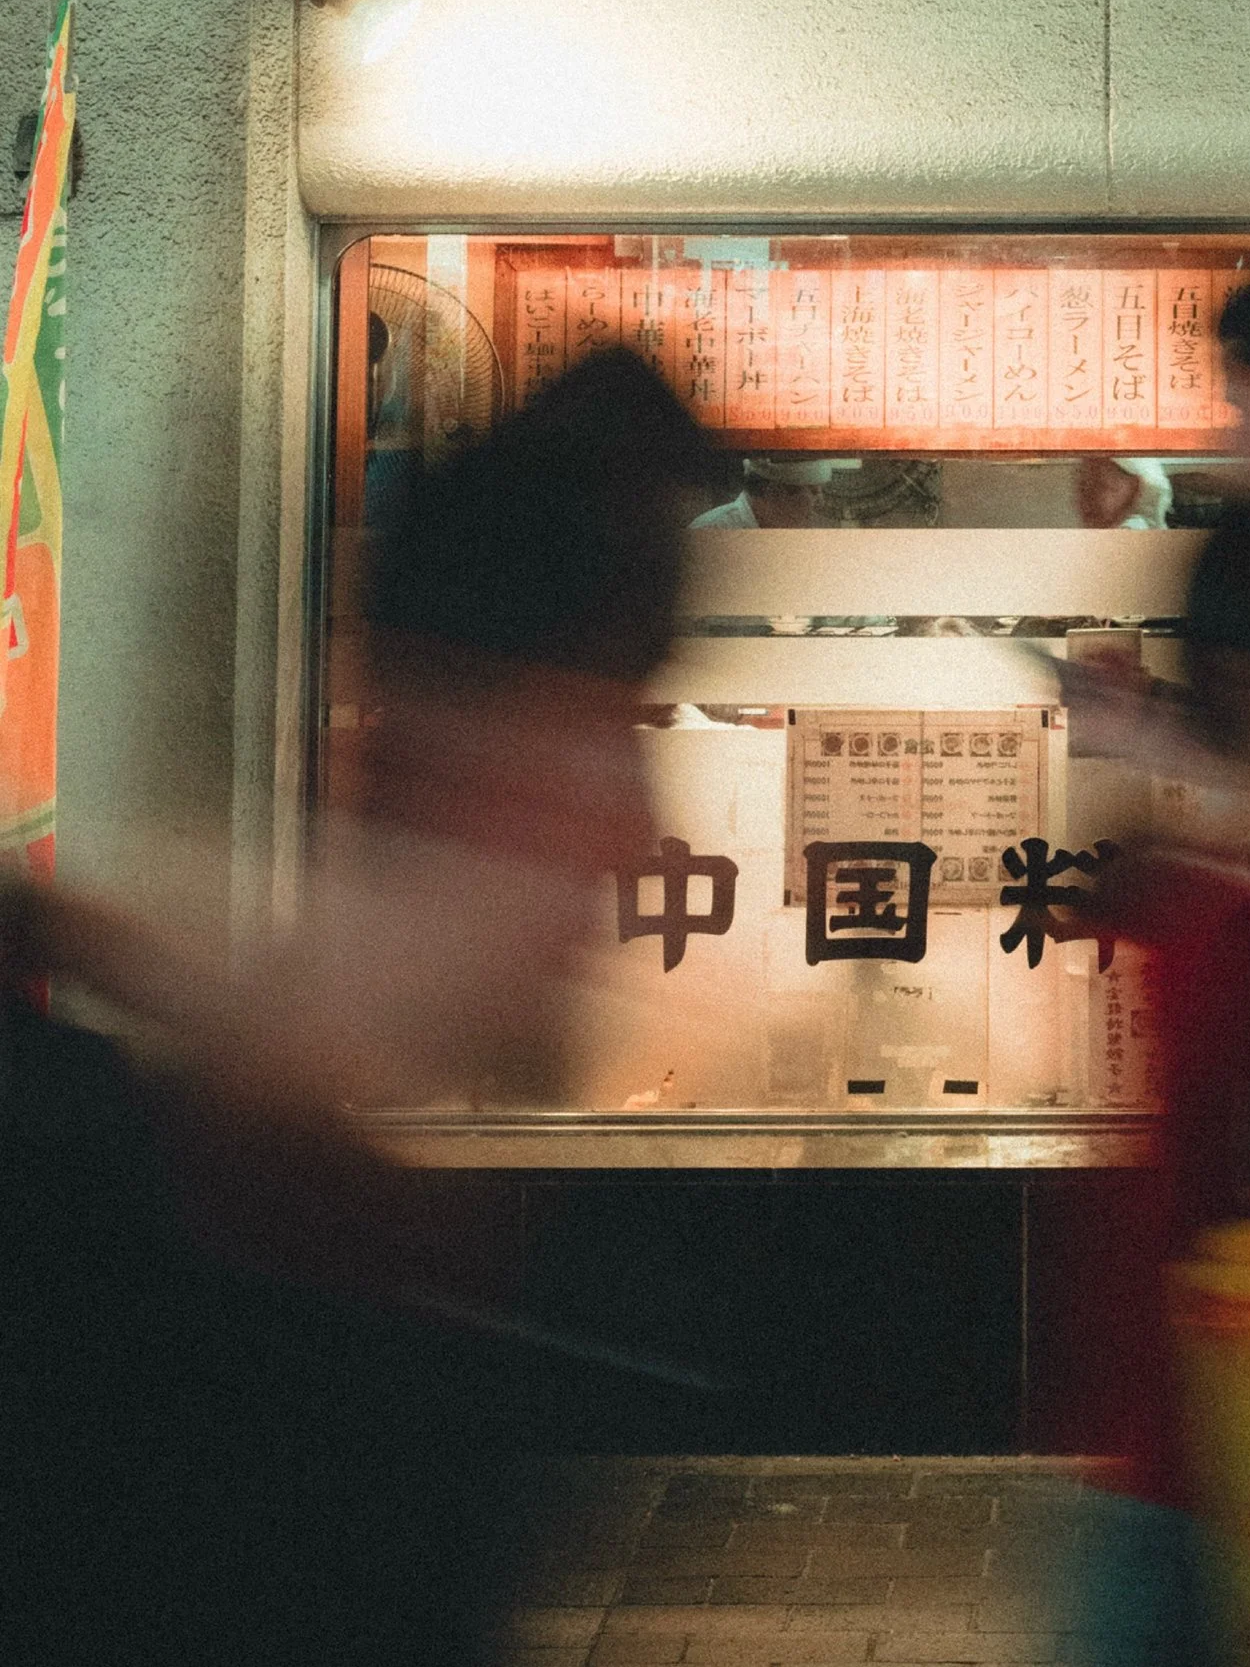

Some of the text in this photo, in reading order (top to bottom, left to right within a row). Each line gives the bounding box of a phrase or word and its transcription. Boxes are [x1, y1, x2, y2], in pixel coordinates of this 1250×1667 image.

[1112, 284, 1146, 402] 五目そば
[1169, 286, 1203, 391] 五目焼きそば
